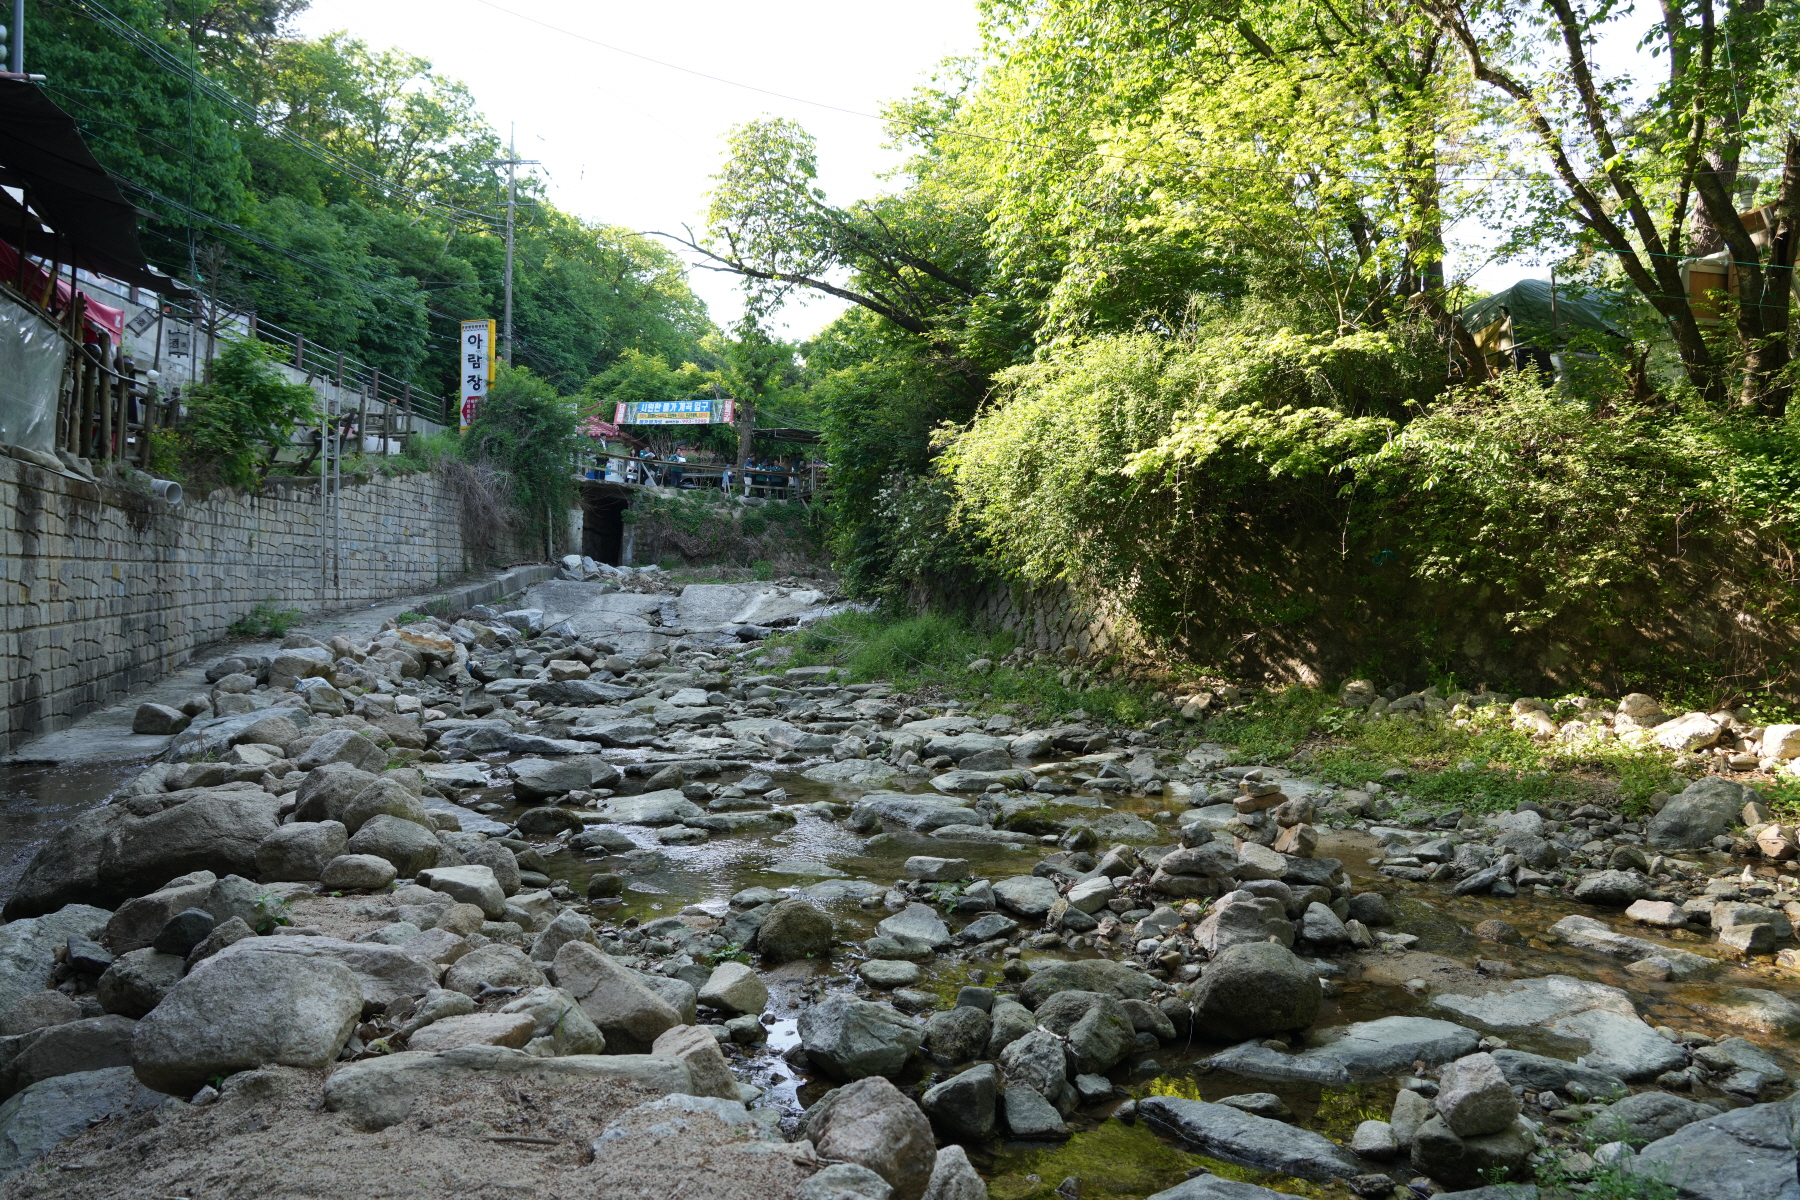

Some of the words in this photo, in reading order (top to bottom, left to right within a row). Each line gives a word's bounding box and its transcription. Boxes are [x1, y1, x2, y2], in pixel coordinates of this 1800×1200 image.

[169, 338, 179, 348] 酒
[467, 333, 483, 392] 아람장
[640, 403, 662, 412] 시원한
[678, 402, 693, 412] 계곡
[694, 401, 709, 411] 입구
